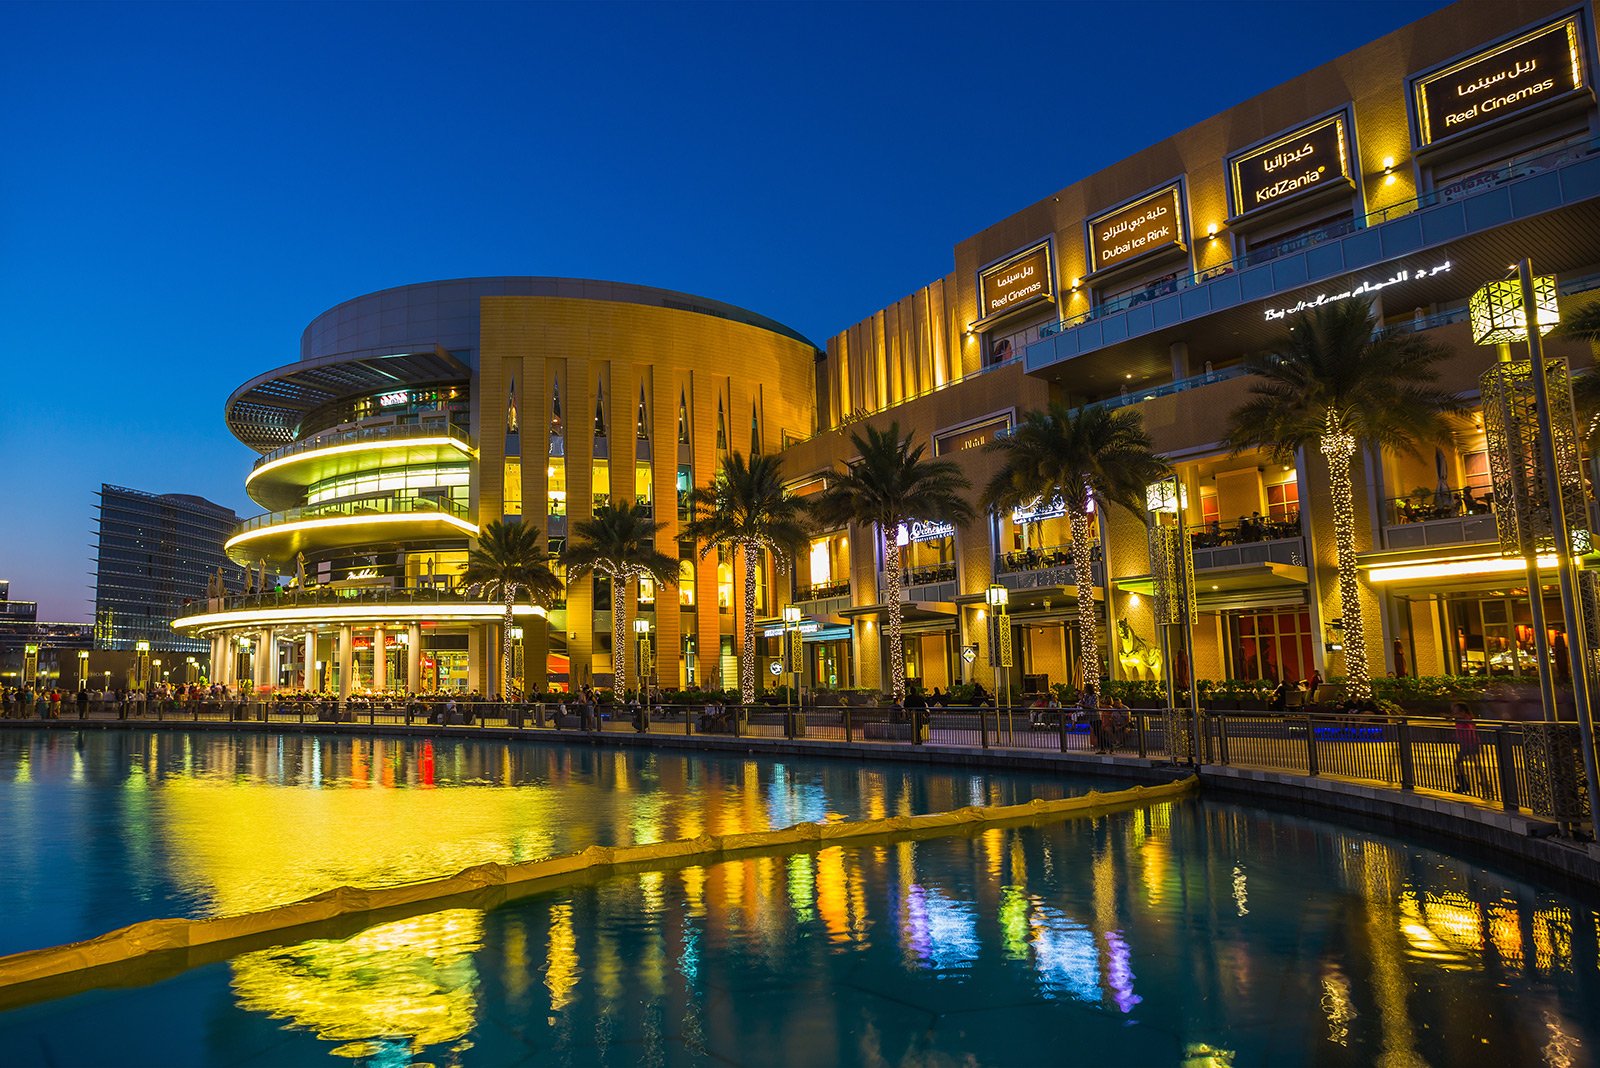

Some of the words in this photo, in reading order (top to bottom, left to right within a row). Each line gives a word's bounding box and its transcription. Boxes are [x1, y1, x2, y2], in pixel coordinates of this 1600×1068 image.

[1508, 59, 1536, 78] ريل
[1457, 71, 1505, 96] سينما
[1445, 104, 1478, 127] Reel
[1481, 78, 1554, 112] Cinemas
[1263, 143, 1314, 172] كيدزانيا
[1256, 170, 1320, 202] KidZania
[1128, 216, 1146, 232] دبي
[1146, 207, 1167, 220] حلبة
[1102, 241, 1131, 260] Dubai
[1132, 236, 1146, 249] Ice
[1147, 226, 1169, 242] Rink
[997, 272, 1020, 287] سينما
[991, 294, 1008, 309] Reel
[1008, 281, 1042, 301] Cinemas
